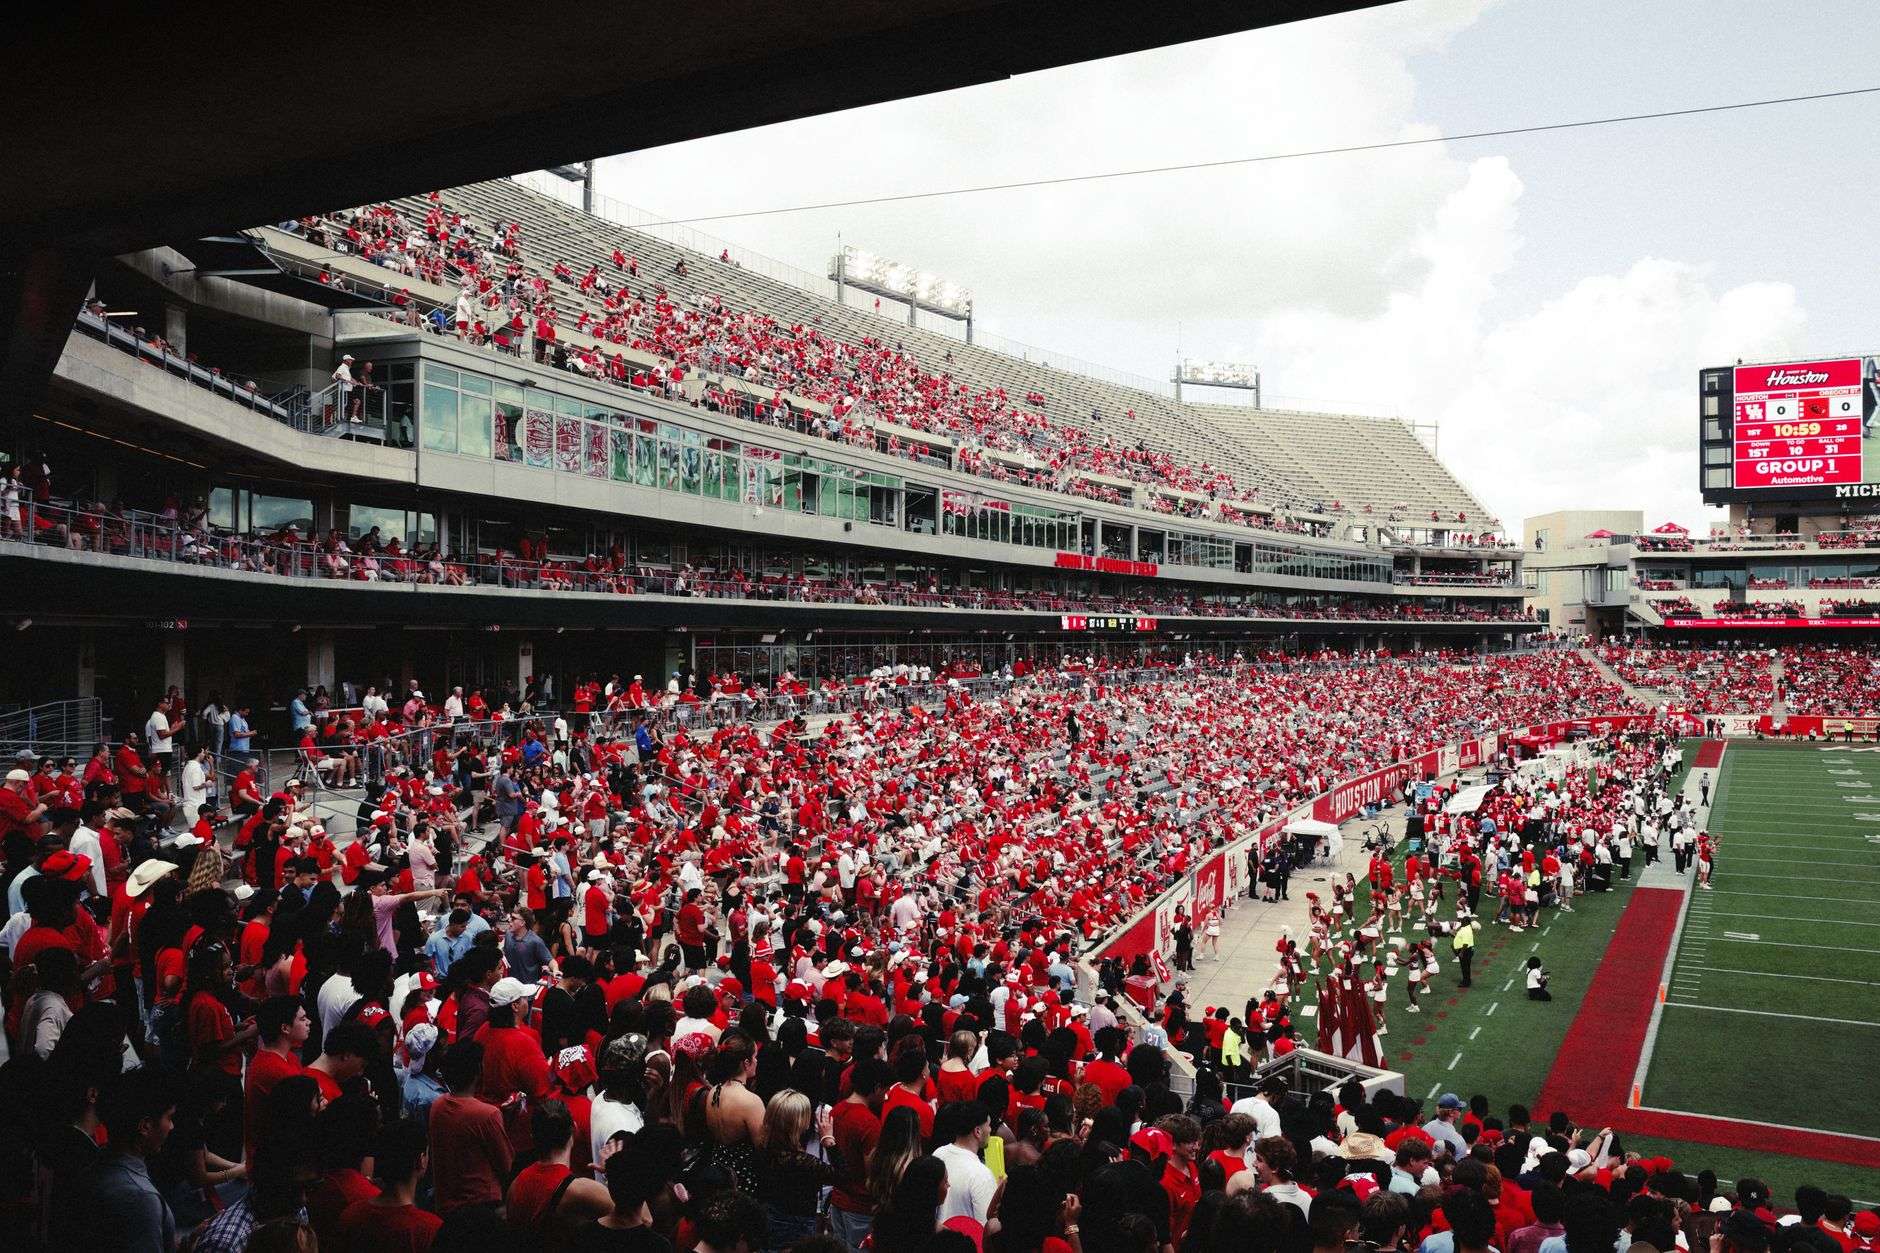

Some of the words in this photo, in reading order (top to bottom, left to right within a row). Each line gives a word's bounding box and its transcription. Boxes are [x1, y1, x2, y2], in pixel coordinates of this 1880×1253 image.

[1766, 369, 1829, 387] Houston
[1777, 406, 1786, 415] 0
[1841, 402, 1850, 411] 0
[1773, 422, 1821, 437] 10:59
[1748, 448, 1769, 457] 1ST
[1788, 446, 1803, 455] 10
[1825, 444, 1839, 453] 31
[1755, 460, 1824, 474] GROUP
[1827, 458, 1836, 471] 1
[1771, 475, 1825, 485] Automotive
[1336, 777, 1380, 819] HOUSTON
